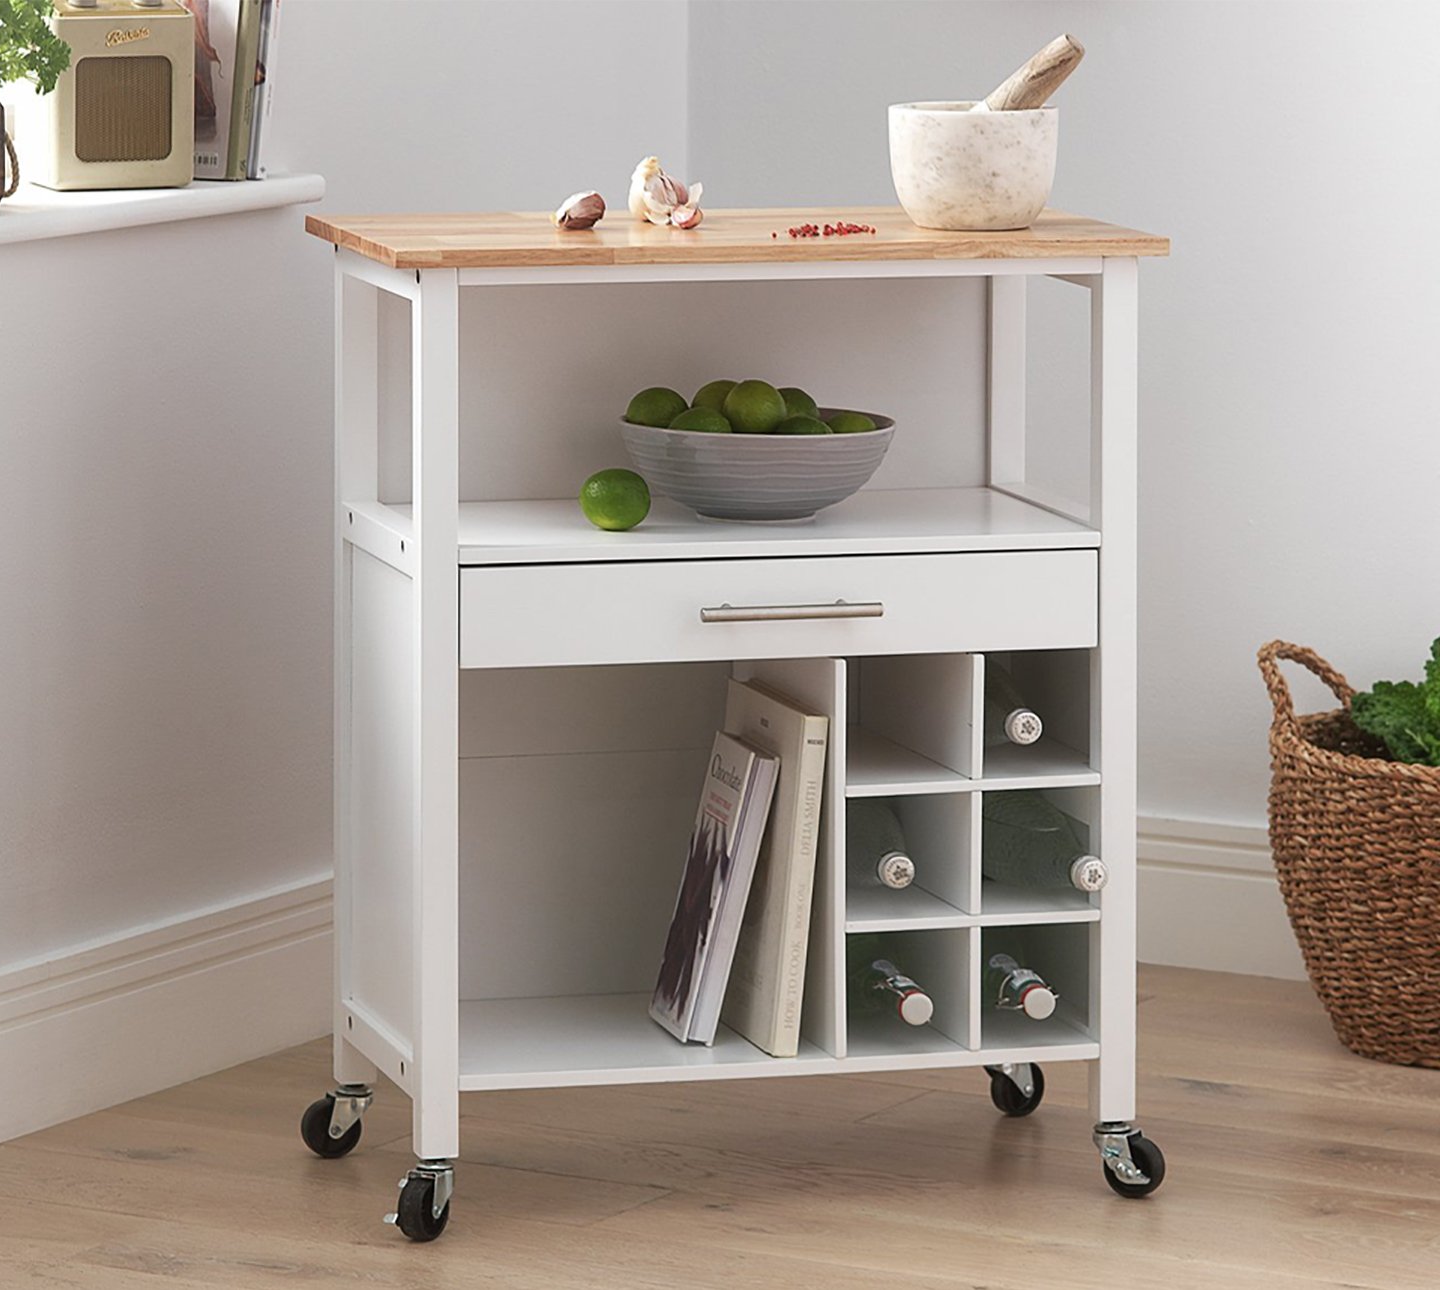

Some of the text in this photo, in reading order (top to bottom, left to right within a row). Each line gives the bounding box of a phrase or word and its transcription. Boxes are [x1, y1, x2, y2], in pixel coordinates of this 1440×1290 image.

[804, 780, 817, 820] SMITH
[800, 823, 812, 856] DELIA
[789, 940, 801, 978] COOK
[787, 980, 797, 996] TO
[783, 1000, 795, 1030] HOW
